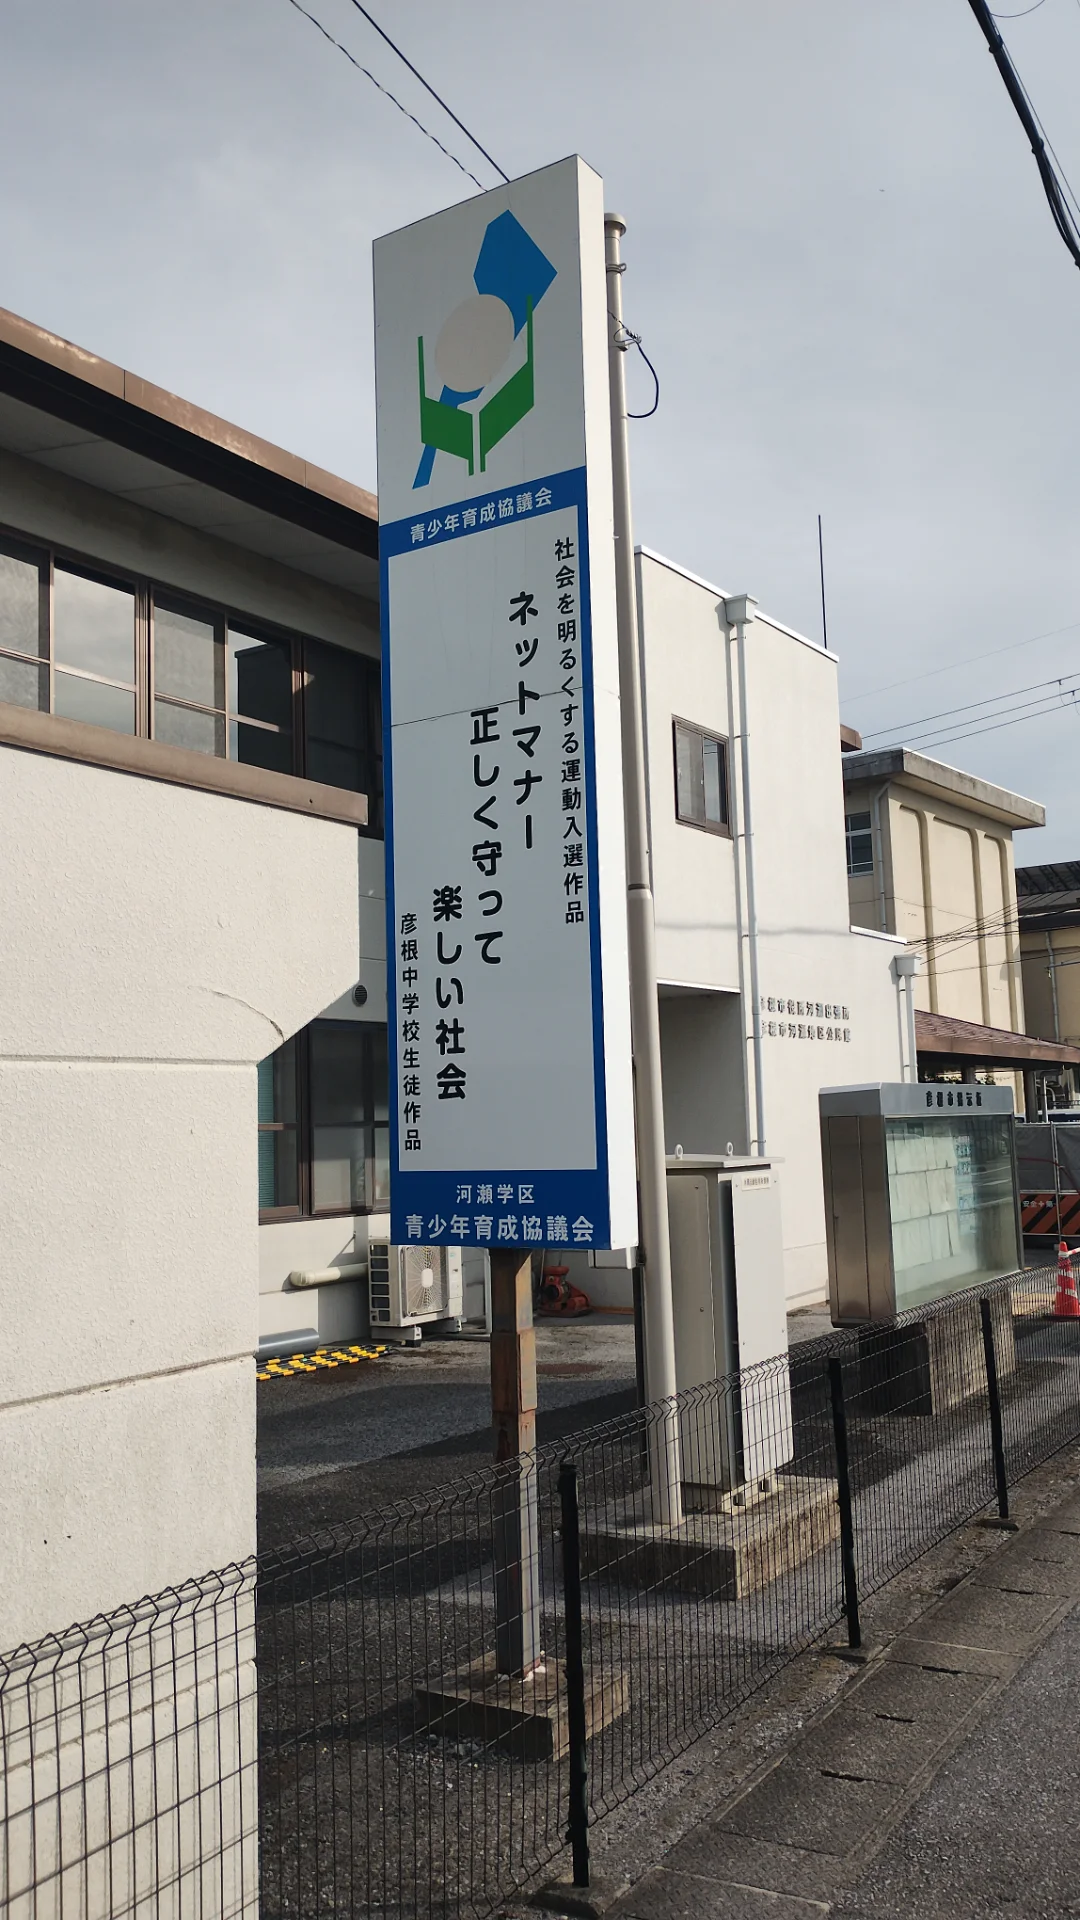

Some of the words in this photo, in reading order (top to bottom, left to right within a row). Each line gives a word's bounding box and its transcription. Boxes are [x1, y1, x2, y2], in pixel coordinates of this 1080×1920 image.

[410, 486, 553, 543] 青少年育成協議会
[508, 590, 543, 850] ネットマナー
[554, 537, 584, 924] 社会を明るくする運動入選作品
[469, 706, 504, 965] 正しく守って
[400, 912, 422, 1151] 彦根中学校生徒作品
[432, 885, 467, 1100] 楽しい社会
[405, 1213, 594, 1243] 青少年育成協議会
[456, 1184, 535, 1204] 河瀬学区
